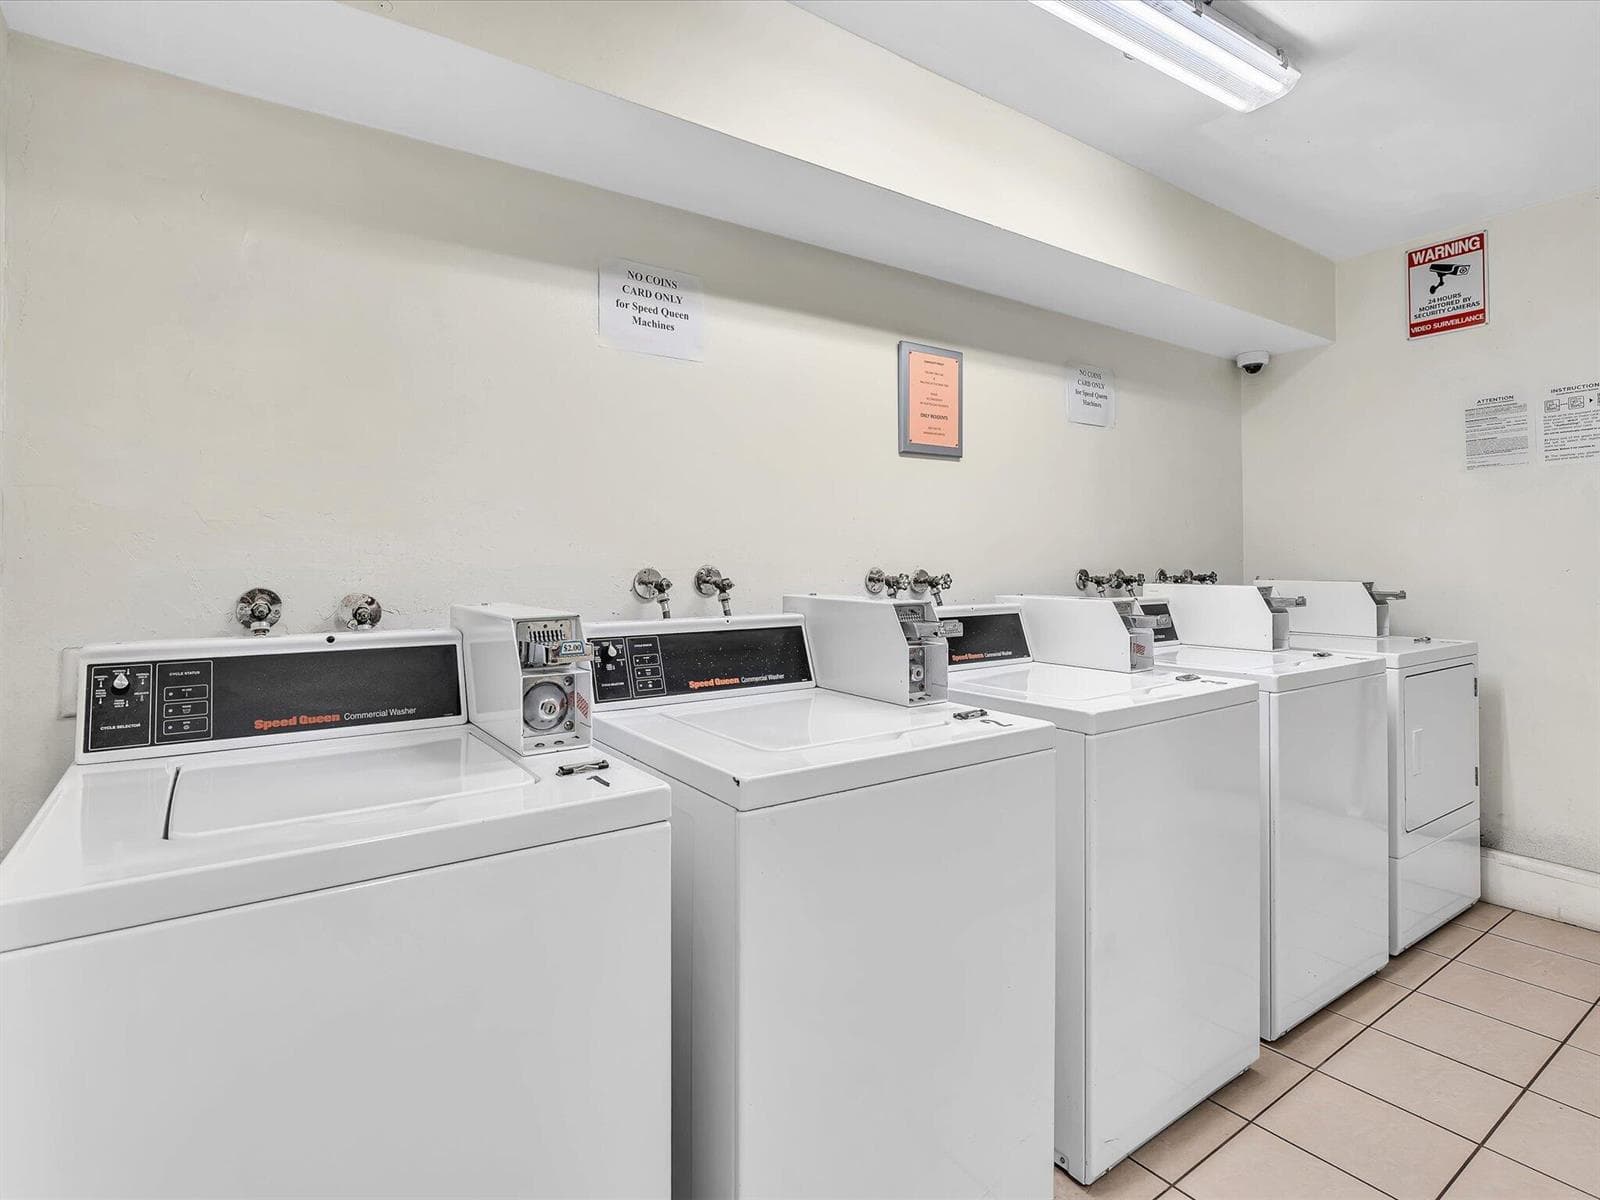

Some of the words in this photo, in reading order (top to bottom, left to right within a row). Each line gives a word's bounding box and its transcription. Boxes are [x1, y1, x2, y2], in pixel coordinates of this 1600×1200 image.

[1412, 237, 1480, 265] WARNING
[627, 270, 643, 281] NO
[646, 275, 678, 289] COINS
[622, 285, 652, 298] CARD
[655, 292, 683, 304] ONLY
[1437, 292, 1462, 302] HOURS
[616, 299, 629, 309] for
[632, 302, 658, 315] Speed
[661, 308, 689, 320] Queen
[1414, 308, 1446, 319] SECURITY
[1447, 301, 1480, 313] CAMERAS
[1419, 300, 1460, 312] MONITORED
[632, 316, 675, 331] Machines
[1411, 324, 1431, 333] VIDEO
[1433, 313, 1484, 329] SURVEILLANCE
[1078, 379, 1090, 387] CARD
[1476, 395, 1514, 404] ATTENTION
[563, 643, 581, 653] $2.00
[952, 654, 968, 662] Speed
[689, 679, 714, 690] Speed
[715, 677, 740, 688] Queen
[741, 675, 767, 683] Commercial
[254, 716, 297, 730] Speed
[299, 713, 341, 727] Queen
[344, 709, 388, 721] Commercial
[389, 707, 417, 717] Washer
